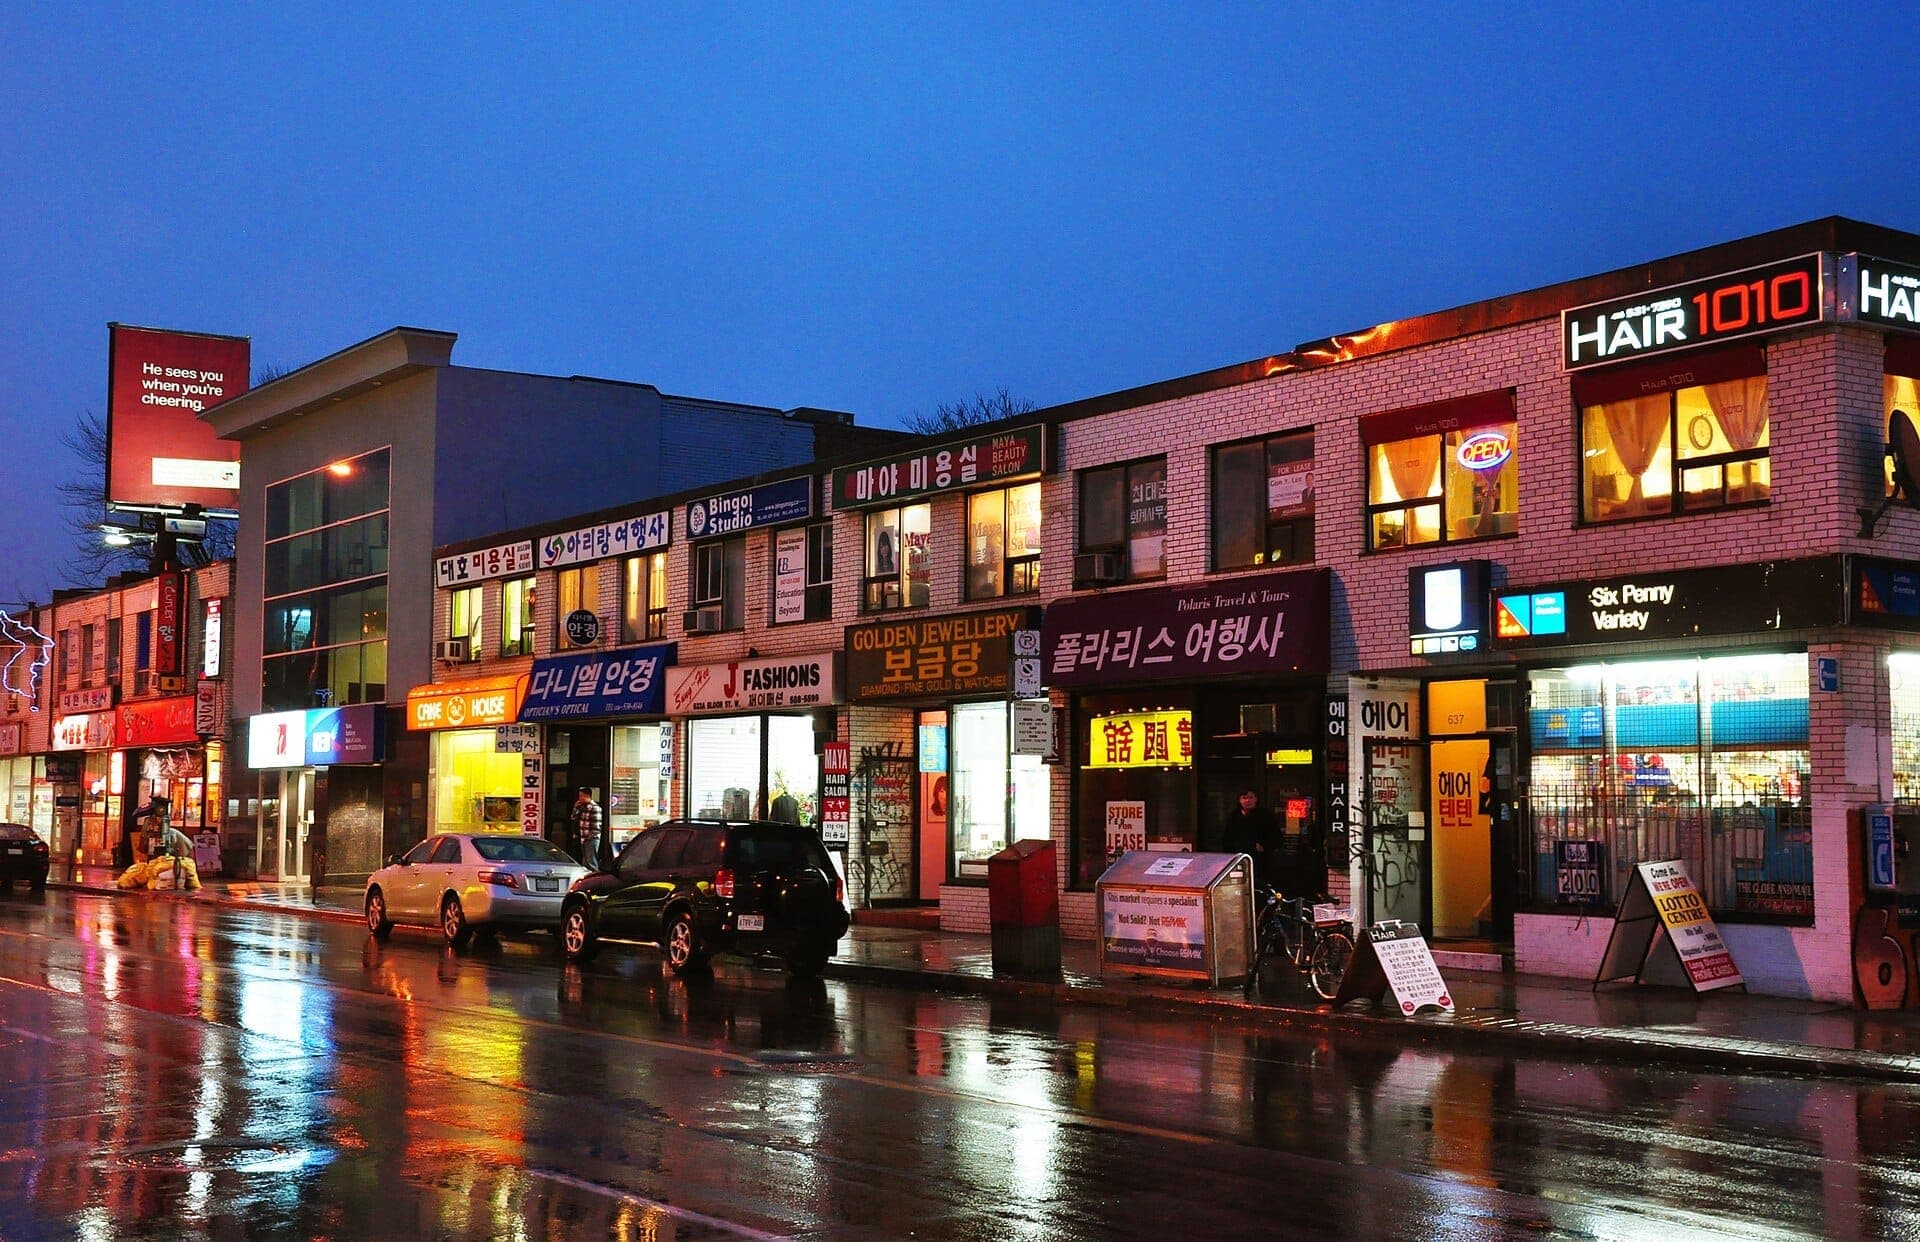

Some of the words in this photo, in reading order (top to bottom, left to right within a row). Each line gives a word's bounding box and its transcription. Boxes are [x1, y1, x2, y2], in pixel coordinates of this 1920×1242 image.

[1571, 307, 1688, 362] HAIR
[1692, 271, 1809, 336] 1010
[143, 362, 162, 376] He
[165, 367, 197, 379] sees
[200, 371, 224, 383] you
[1670, 372, 1695, 386] 1010
[142, 379, 180, 393] when
[182, 384, 223, 396] you're
[142, 393, 206, 412] cheering.
[1439, 418, 1459, 429] 1010
[992, 435, 1016, 451] MAYA
[1463, 438, 1509, 462] OPEN
[992, 446, 1027, 463] BEAUTY
[856, 464, 898, 500] 마야
[910, 445, 977, 489] 미용실
[992, 461, 1021, 477] SALON
[1277, 467, 1290, 475] FOR
[1293, 463, 1311, 472] LEASE
[709, 493, 753, 516] Bingo!
[709, 511, 752, 534] Studio
[566, 527, 611, 561] 아리랑
[614, 513, 665, 549] 여행사
[440, 557, 469, 582] 대호
[472, 545, 517, 574] 미용실
[777, 589, 805, 599] Education
[1177, 597, 1211, 612] Polaris
[1214, 592, 1246, 609] Travel
[1247, 592, 1257, 605] &
[1261, 588, 1290, 604] Tours
[1591, 587, 1618, 607] Six
[1621, 583, 1674, 606] Penny
[778, 604, 801, 616] Beyond
[1592, 609, 1650, 631] Variety
[568, 622, 597, 639] 안경
[853, 625, 917, 651] GOLDEN
[921, 613, 1019, 647] JEWELLERY
[1052, 625, 1177, 674] 폴라리스
[1184, 612, 1286, 663] 여행사
[883, 641, 982, 683] 보금당
[531, 662, 602, 700] 다니엘
[602, 657, 657, 697] 안경
[743, 663, 820, 691] FASHIONS
[903, 681, 924, 692] FINE
[926, 679, 952, 692] GOLD
[954, 679, 962, 690] &
[471, 695, 505, 717] HOUSE
[560, 703, 589, 715] OPTICAL
[706, 701, 724, 709] BLOOR
[1328, 701, 1345, 737] 헤어
[1361, 700, 1409, 732] 헤어
[1447, 714, 1465, 725] 637
[497, 725, 539, 738] 아리랑
[497, 739, 539, 753] 여행사
[824, 748, 848, 770] MAYA
[523, 758, 541, 788] 대호
[825, 774, 846, 785] HAIR
[824, 786, 848, 796] SALON
[1438, 771, 1472, 799] 헤어
[523, 791, 541, 832] 미용실
[827, 800, 846, 809] マヤ
[1108, 806, 1143, 819] STORE
[1330, 783, 1346, 833] HAIR
[1439, 798, 1473, 828] 텐텐
[1108, 834, 1143, 850] LEASE
[1651, 867, 1669, 879] Come
[1671, 877, 1691, 890] OPEN
[1108, 893, 1118, 902] This
[1119, 895, 1141, 904] market
[1141, 896, 1163, 906] requires
[1168, 896, 1200, 908] specialist.
[1660, 894, 1699, 912] LOTTO
[1118, 914, 1130, 924] Not
[1130, 915, 1147, 925] Sold?
[1149, 916, 1161, 927] Not
[1667, 908, 1706, 925] CENTRE
[1106, 943, 1128, 953] Choose
[1156, 948, 1180, 958] Choose
